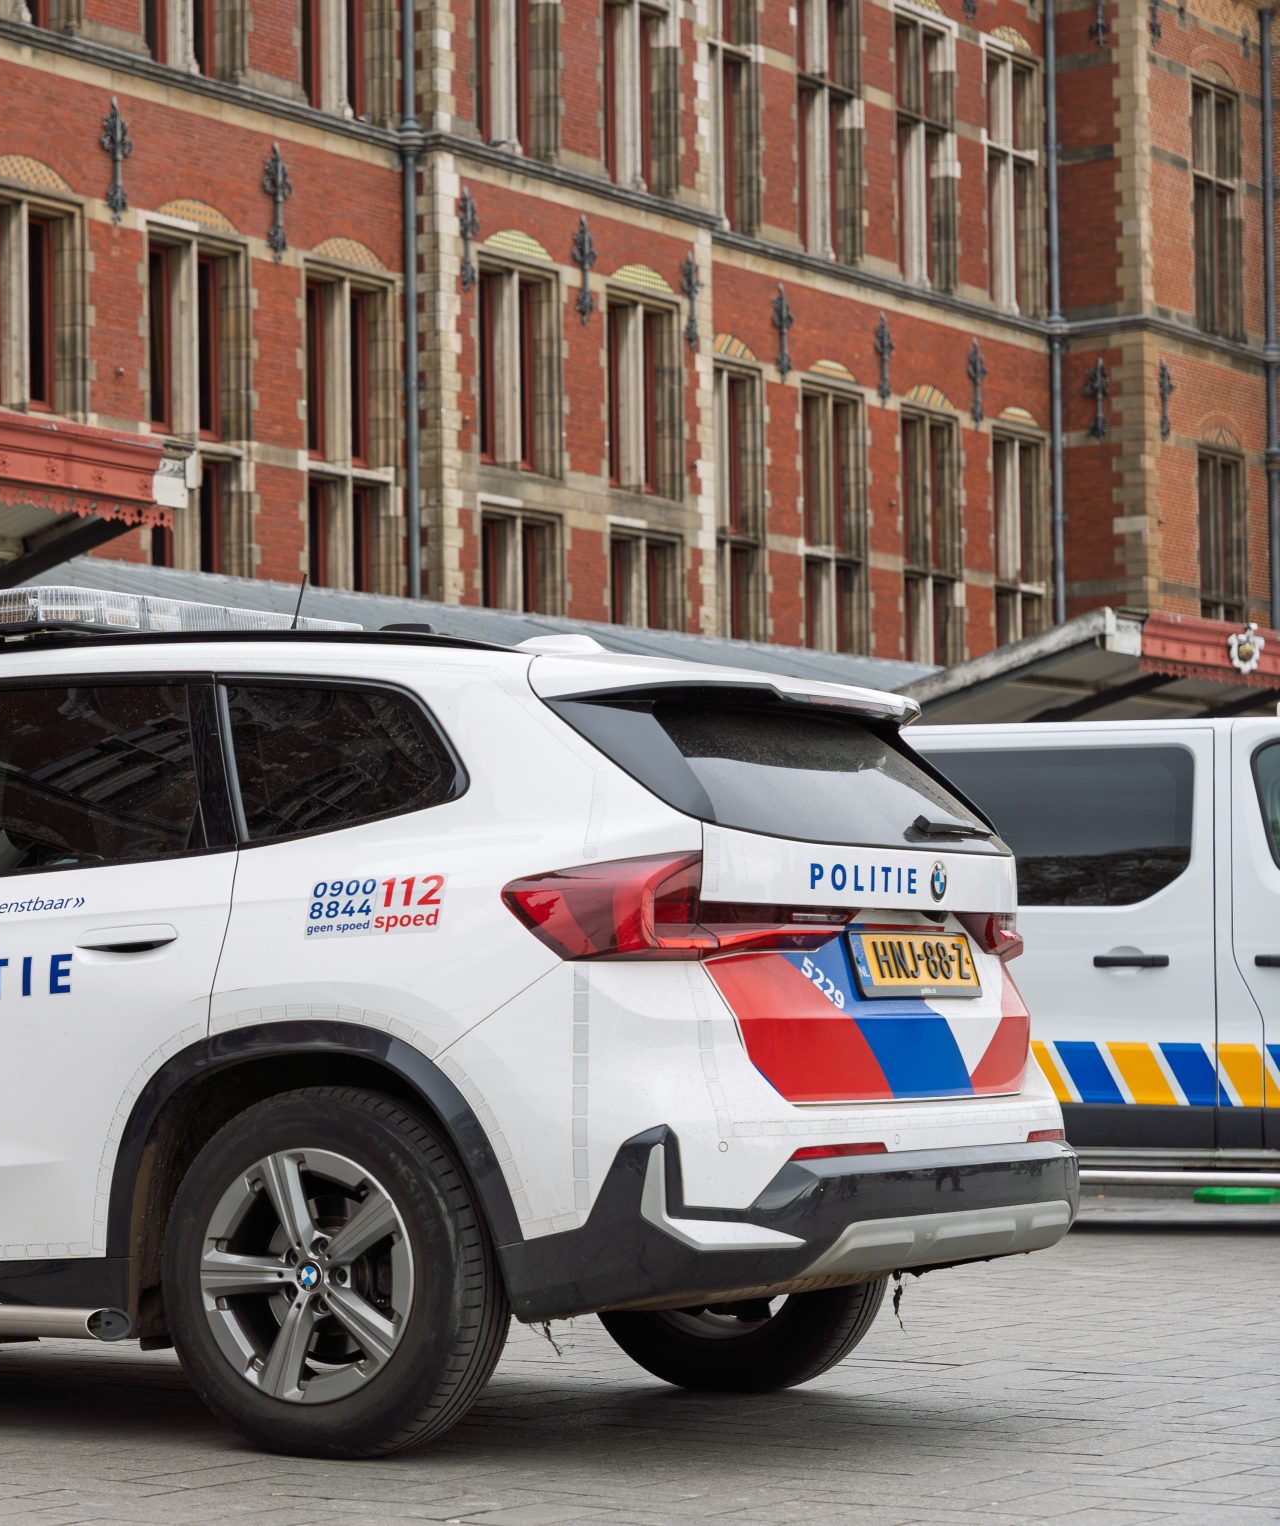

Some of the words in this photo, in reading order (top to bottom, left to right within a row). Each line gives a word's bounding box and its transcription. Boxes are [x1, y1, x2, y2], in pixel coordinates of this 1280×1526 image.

[313, 878, 377, 899] 0900
[809, 862, 918, 895] POLITIE
[381, 874, 445, 908] 112
[309, 899, 372, 920] 8844
[374, 908, 439, 932] spoed
[307, 923, 333, 935] geen
[336, 920, 370, 933] spoed
[858, 966, 870, 977] NL
[871, 941, 971, 980] HNJ-88-Z
[800, 956, 845, 1010] 5229
